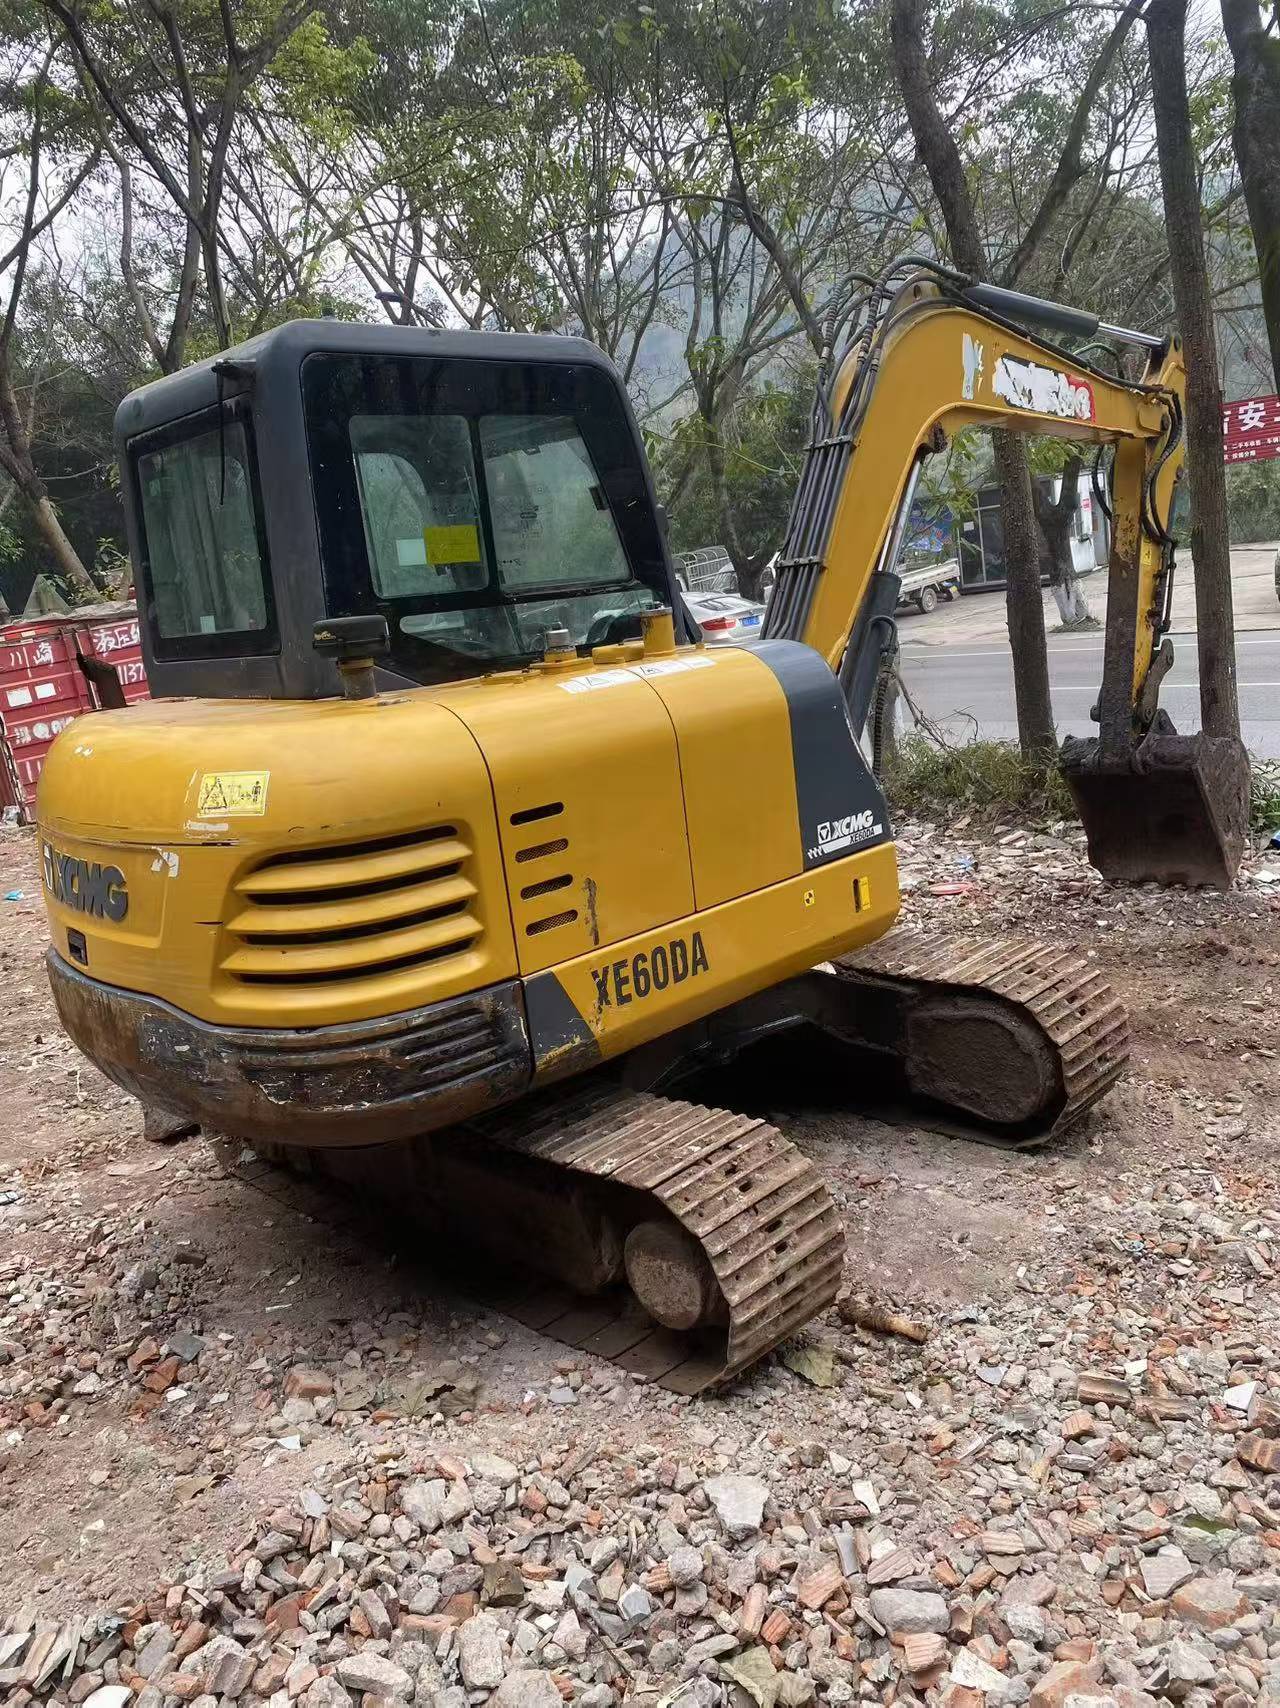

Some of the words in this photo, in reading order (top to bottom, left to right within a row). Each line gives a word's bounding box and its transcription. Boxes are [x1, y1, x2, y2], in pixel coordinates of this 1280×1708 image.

[117, 662, 147, 685] 1137
[832, 809, 874, 839] XCMG
[849, 828, 875, 845] XE60DA
[50, 848, 129, 922] XCMG
[591, 931, 709, 1006] XE60DA
